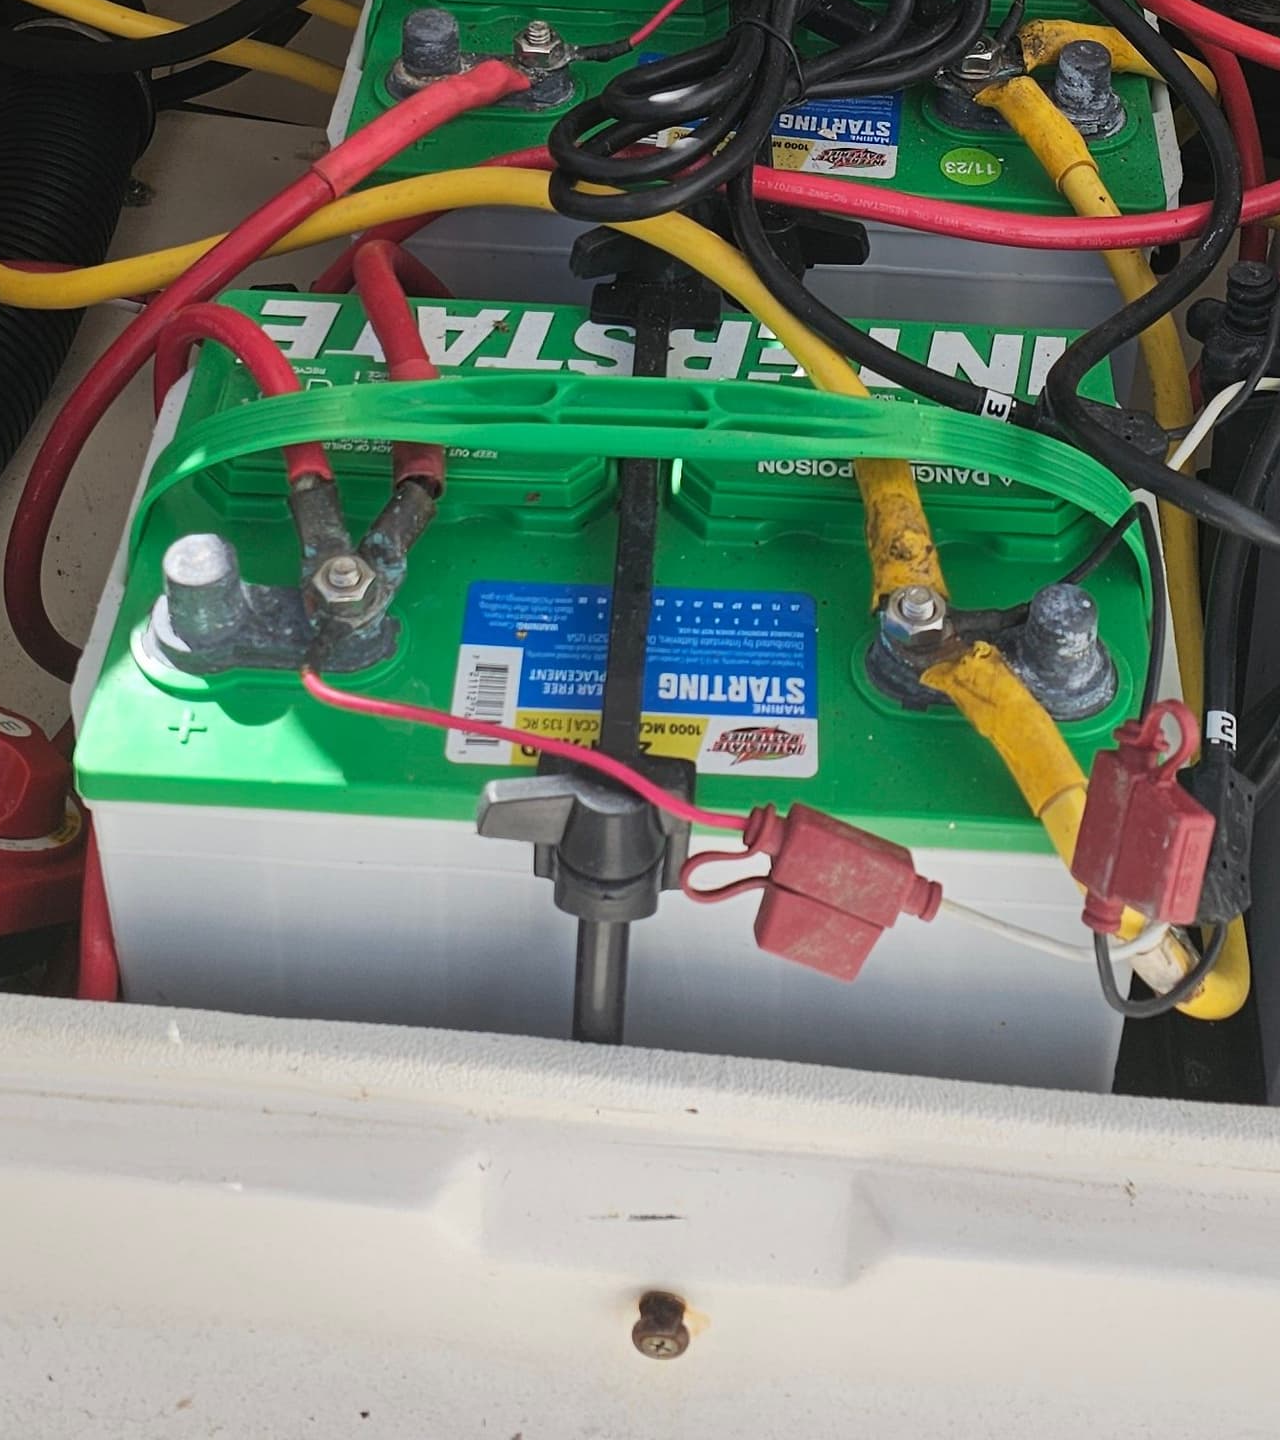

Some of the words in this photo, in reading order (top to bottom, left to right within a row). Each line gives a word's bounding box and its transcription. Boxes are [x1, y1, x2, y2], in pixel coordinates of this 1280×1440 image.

[778, 113, 891, 136] STARTING
[784, 141, 809, 151] 1000
[943, 159, 998, 177] 11/23
[756, 458, 854, 478] POISON
[700, 638, 741, 649] Interstate
[743, 637, 754, 649] by
[755, 639, 804, 651] Distributed
[542, 682, 575, 695] FREE
[657, 672, 805, 704] STARTING
[752, 703, 805, 715] MARINE
[522, 717, 538, 730] RC
[542, 718, 563, 731] 135
[574, 719, 599, 732] CCA
[670, 722, 702, 737] 1000
[1221, 715, 1234, 736] 2
